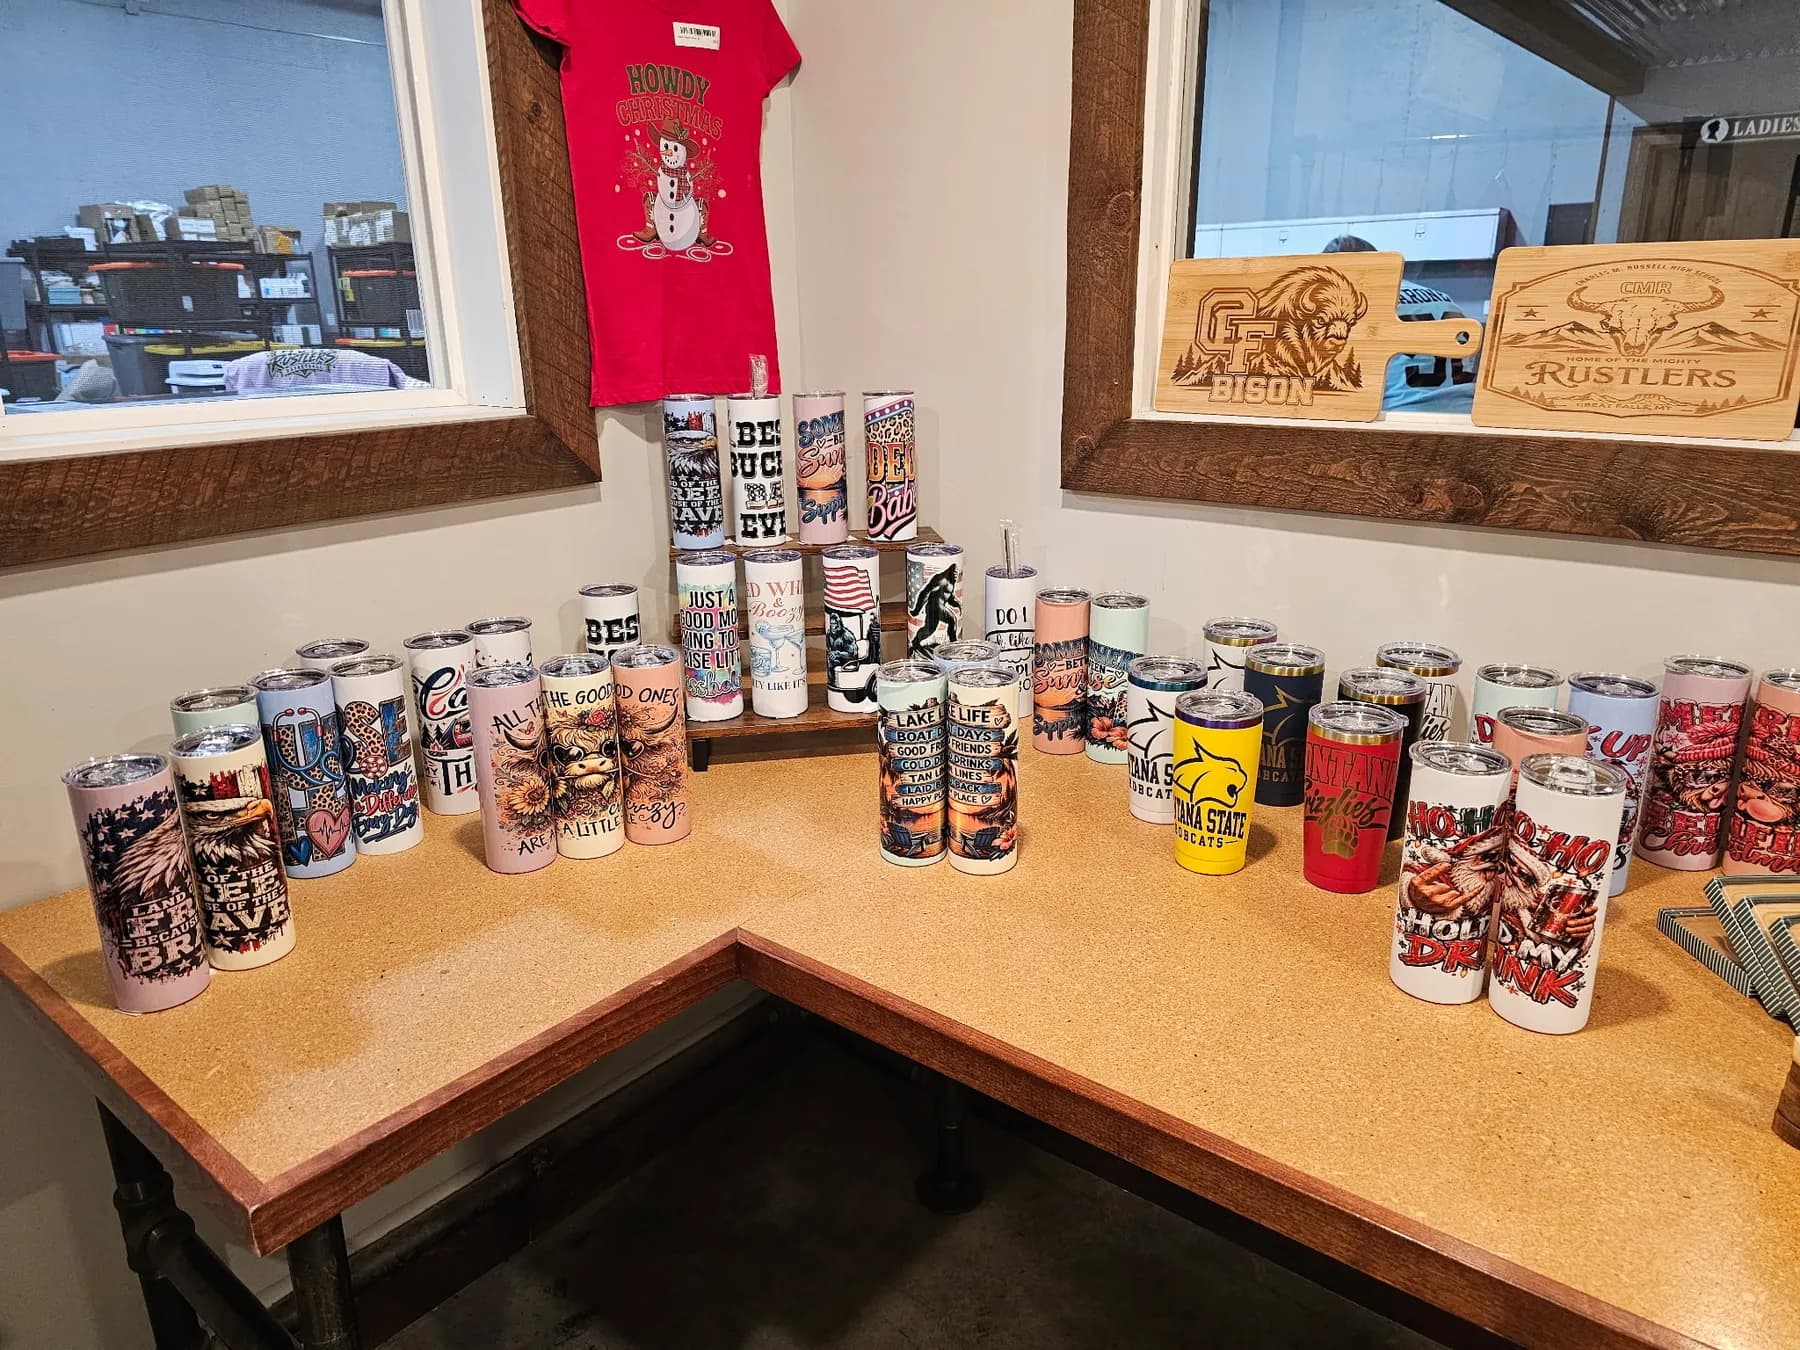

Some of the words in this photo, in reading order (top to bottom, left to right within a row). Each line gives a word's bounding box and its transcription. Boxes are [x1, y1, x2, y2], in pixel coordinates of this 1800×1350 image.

[625, 63, 711, 105] HOWDY
[616, 98, 723, 140] CHRISTMAS
[1620, 281, 1673, 295] CMR
[268, 351, 337, 378] RUSTLERS
[1524, 361, 1737, 388] RUSTLERS
[1208, 374, 1318, 407] BISON
[689, 591, 724, 609] JUST
[728, 588, 735, 606] A
[996, 607, 1018, 625] DO
[639, 687, 679, 707] ONES
[491, 710, 528, 734] ALL
[896, 711, 936, 728] LAKE
[959, 708, 991, 723] LIFE
[896, 730, 934, 742] BOAT
[957, 727, 992, 741] DAYS
[897, 745, 927, 757] GOOD
[951, 739, 992, 754] FRIENDS
[1601, 730, 1652, 762] UP
[902, 760, 931, 770] COLD
[954, 756, 992, 769] DRINKS
[350, 769, 410, 800] Making
[908, 772, 932, 783] TAN
[955, 768, 983, 781] LINES
[907, 785, 932, 794] LAID
[955, 780, 980, 793] BACK
[902, 795, 932, 806] HAPPY
[953, 792, 978, 803] PLACE
[1206, 808, 1247, 839] STATE
[518, 835, 547, 856] ARE
[1175, 824, 1224, 848] OBCATS
[206, 874, 231, 884] OF
[237, 861, 273, 881] THE
[132, 892, 186, 917] LAND
[226, 901, 247, 912] OF
[251, 889, 279, 907] THE
[1518, 938, 1580, 973] MY
